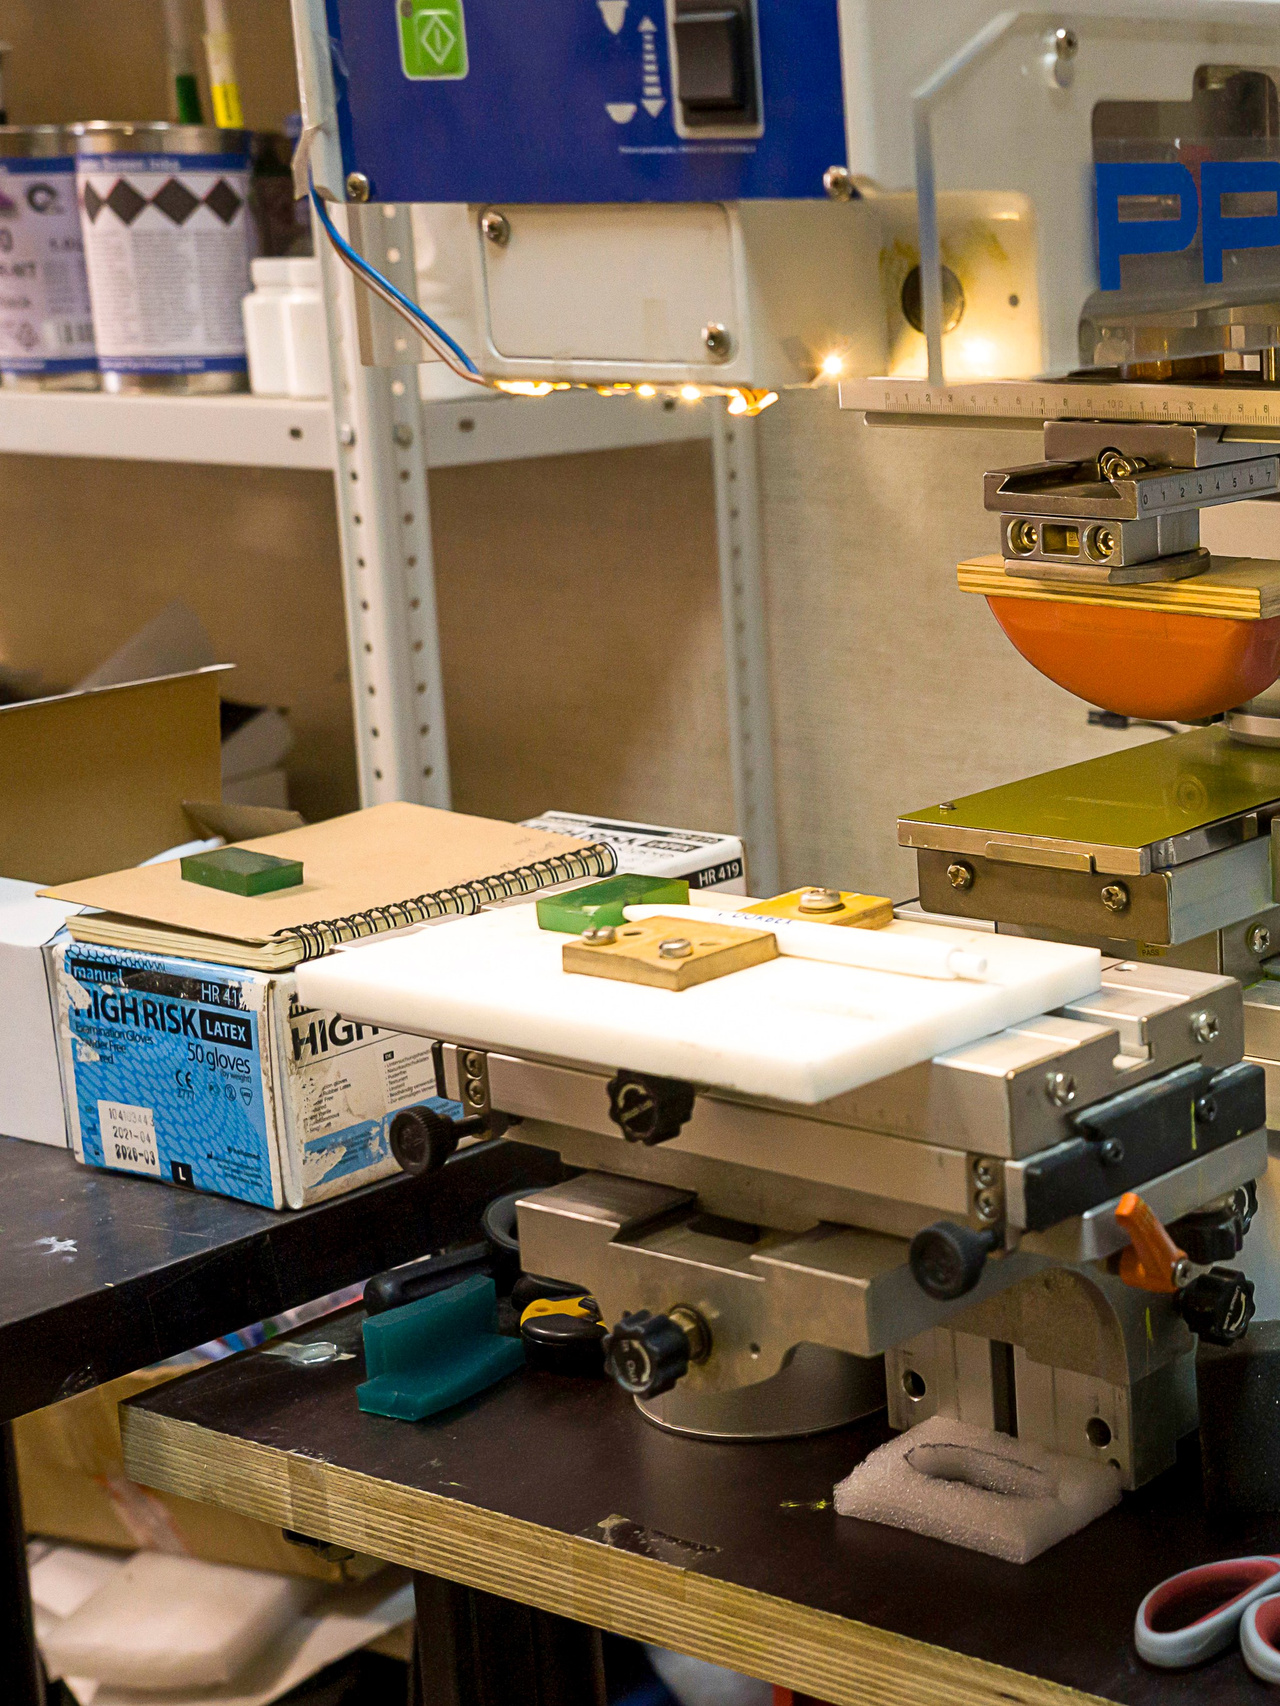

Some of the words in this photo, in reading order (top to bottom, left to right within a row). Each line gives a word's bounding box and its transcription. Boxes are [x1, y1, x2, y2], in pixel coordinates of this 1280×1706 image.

[1143, 494, 1148, 505] 0
[1162, 491, 1166, 500] 1
[1180, 487, 1185, 498] 2
[1198, 484, 1203, 494] 3
[1215, 481, 1220, 491] 4
[1233, 477, 1237, 488] 5
[1249, 474, 1254, 485] 6
[1266, 471, 1271, 481] 7
[699, 869, 717, 888] HR
[718, 862, 740, 882] 419
[72, 964, 123, 984] manual
[201, 983, 220, 1004] HR
[143, 1000, 199, 1038] RISK
[205, 1019, 247, 1042] LATEX
[187, 1042, 204, 1062] 50
[206, 1048, 251, 1075] gloves
[179, 1166, 187, 1181] L
